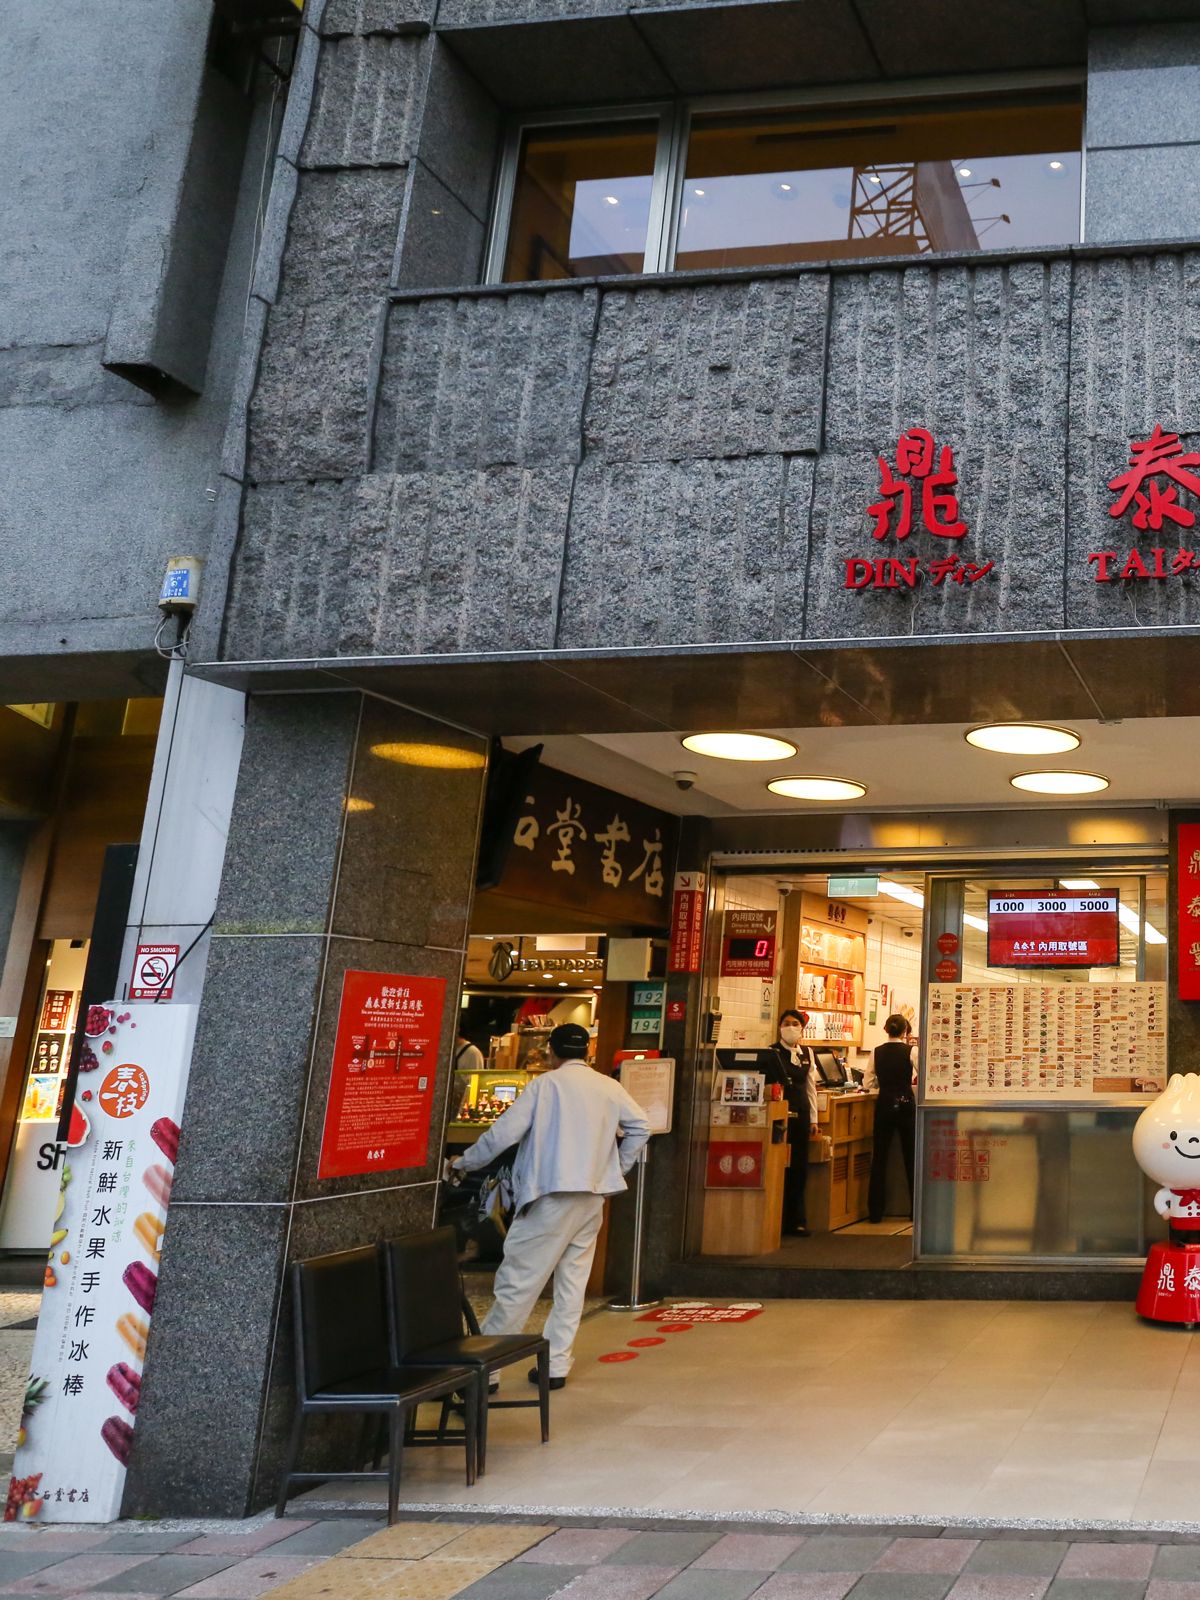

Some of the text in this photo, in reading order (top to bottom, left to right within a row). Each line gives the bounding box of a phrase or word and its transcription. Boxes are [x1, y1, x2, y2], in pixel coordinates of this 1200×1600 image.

[843, 557, 919, 588] DIN
[927, 558, 995, 585] ディン
[1087, 547, 1168, 582] TAI
[996, 900, 1109, 912] 1000 3000 5000
[755, 940, 768, 957] 0
[1038, 940, 1088, 951] 內用取號區
[636, 991, 663, 1003] 192
[634, 1020, 660, 1031] 194
[62, 1140, 124, 1396] 新鮮水果手作冰棒
